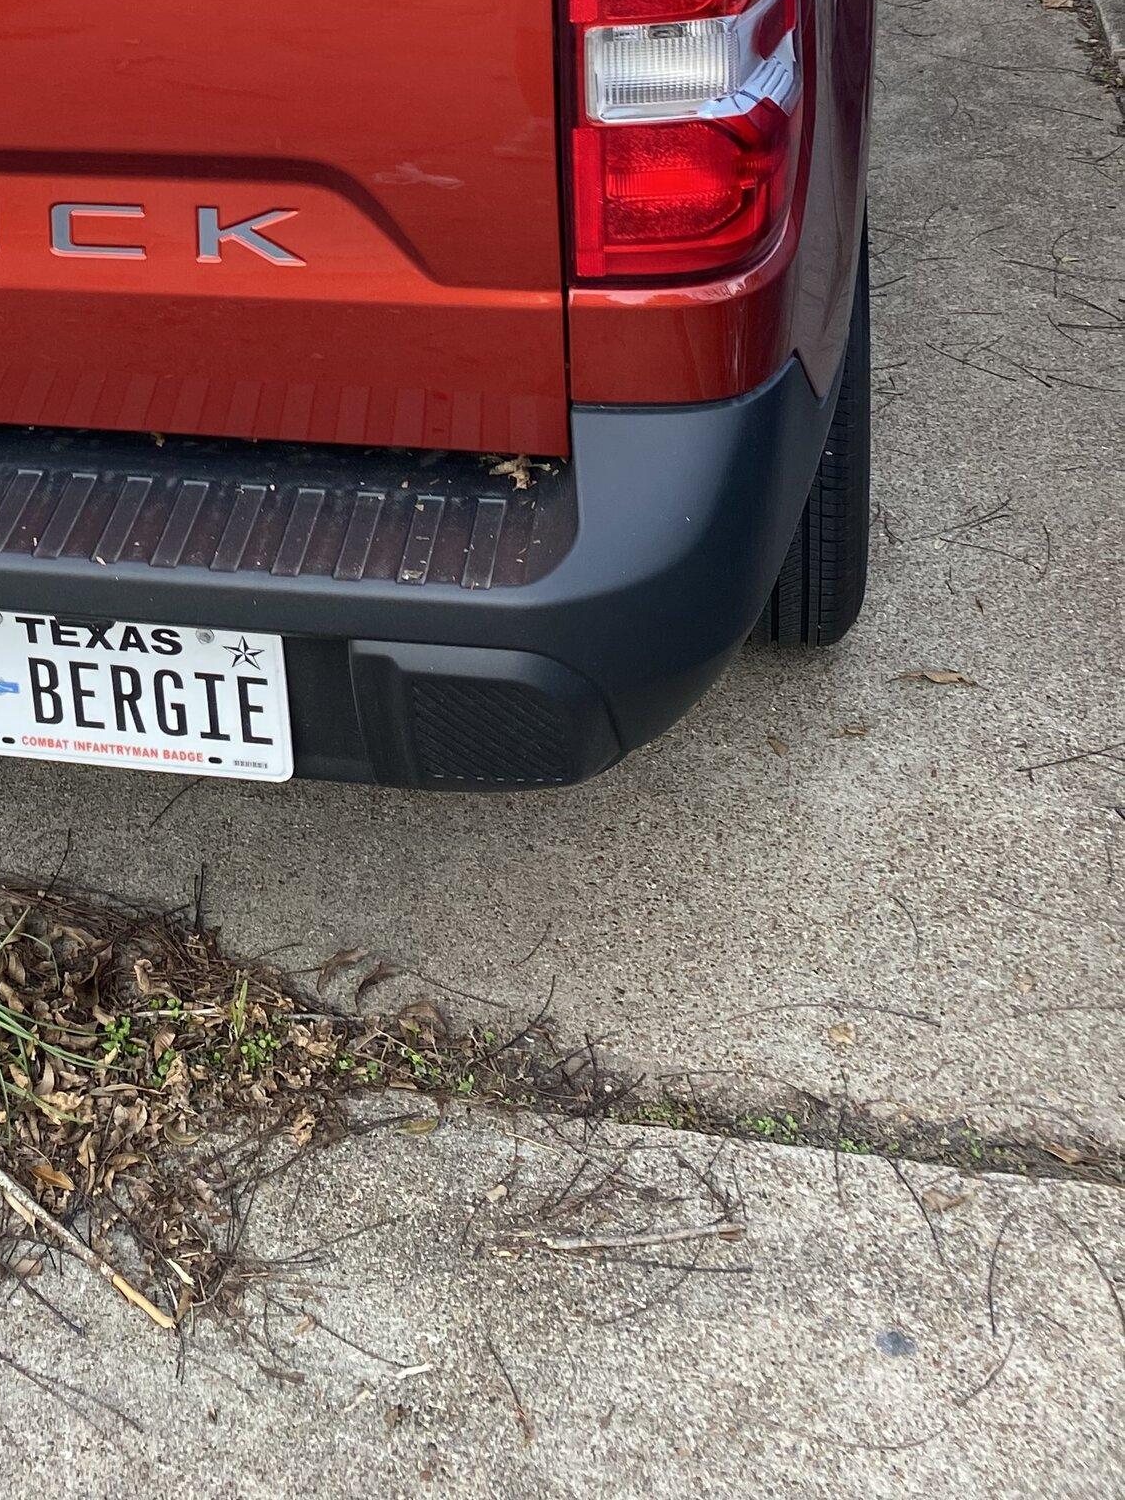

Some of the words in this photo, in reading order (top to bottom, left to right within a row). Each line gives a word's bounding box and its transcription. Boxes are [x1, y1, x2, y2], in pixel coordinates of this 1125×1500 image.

[15, 615, 183, 656] TEXAS
[28, 656, 274, 746] BERGIE
[22, 735, 69, 750] COMBAT
[74, 740, 159, 759] INFANTRYMAN
[162, 749, 204, 763] BADGE
